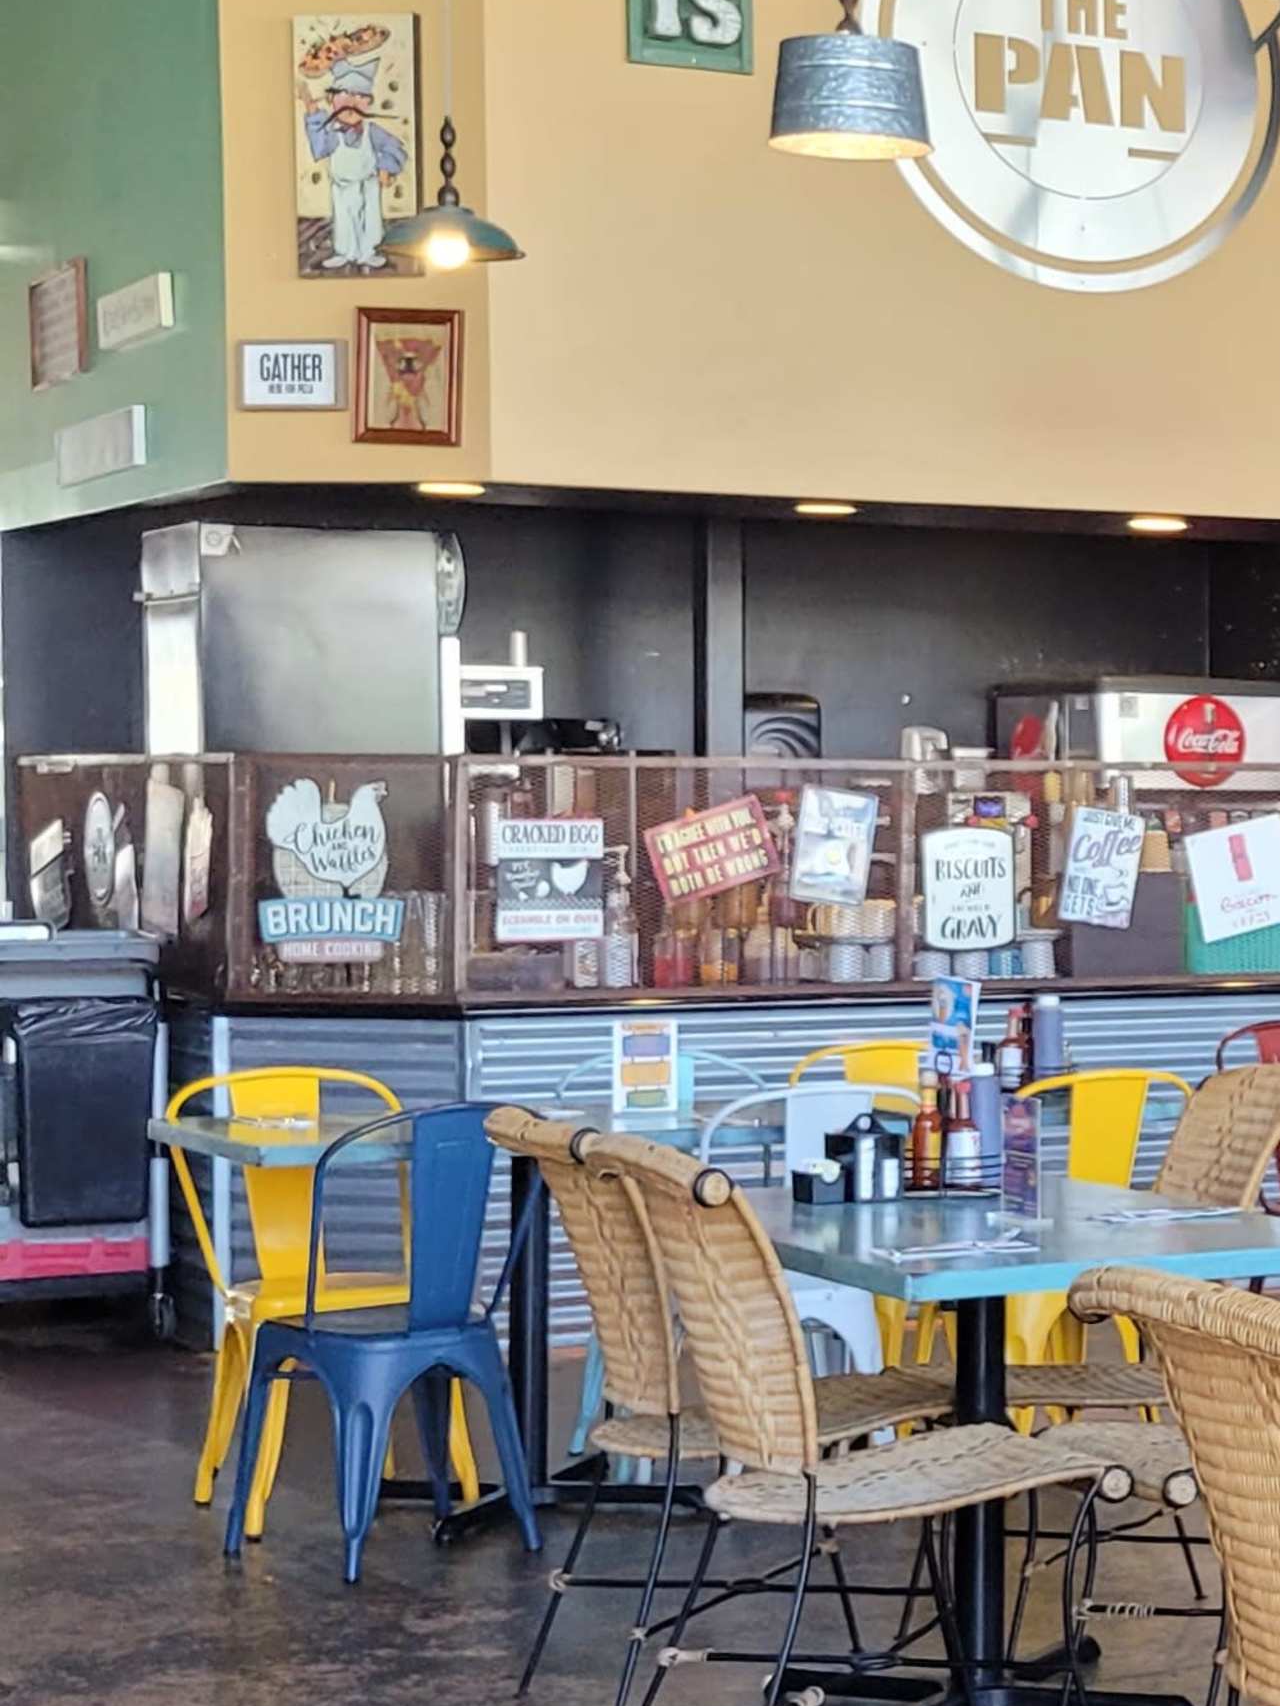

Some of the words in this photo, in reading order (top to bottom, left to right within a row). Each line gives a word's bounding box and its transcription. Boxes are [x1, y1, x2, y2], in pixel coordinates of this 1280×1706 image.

[973, 32, 1188, 135] PAN
[259, 353, 322, 383] GATHER
[293, 820, 381, 855] Chicken
[502, 824, 566, 844] CRACKED
[569, 824, 599, 844] EGG
[1072, 829, 1142, 869] Coffee
[310, 846, 377, 873] Waffles
[935, 856, 1007, 881] BISCUITS
[266, 900, 397, 936] BRUNCH
[940, 914, 1003, 940] GRAVY
